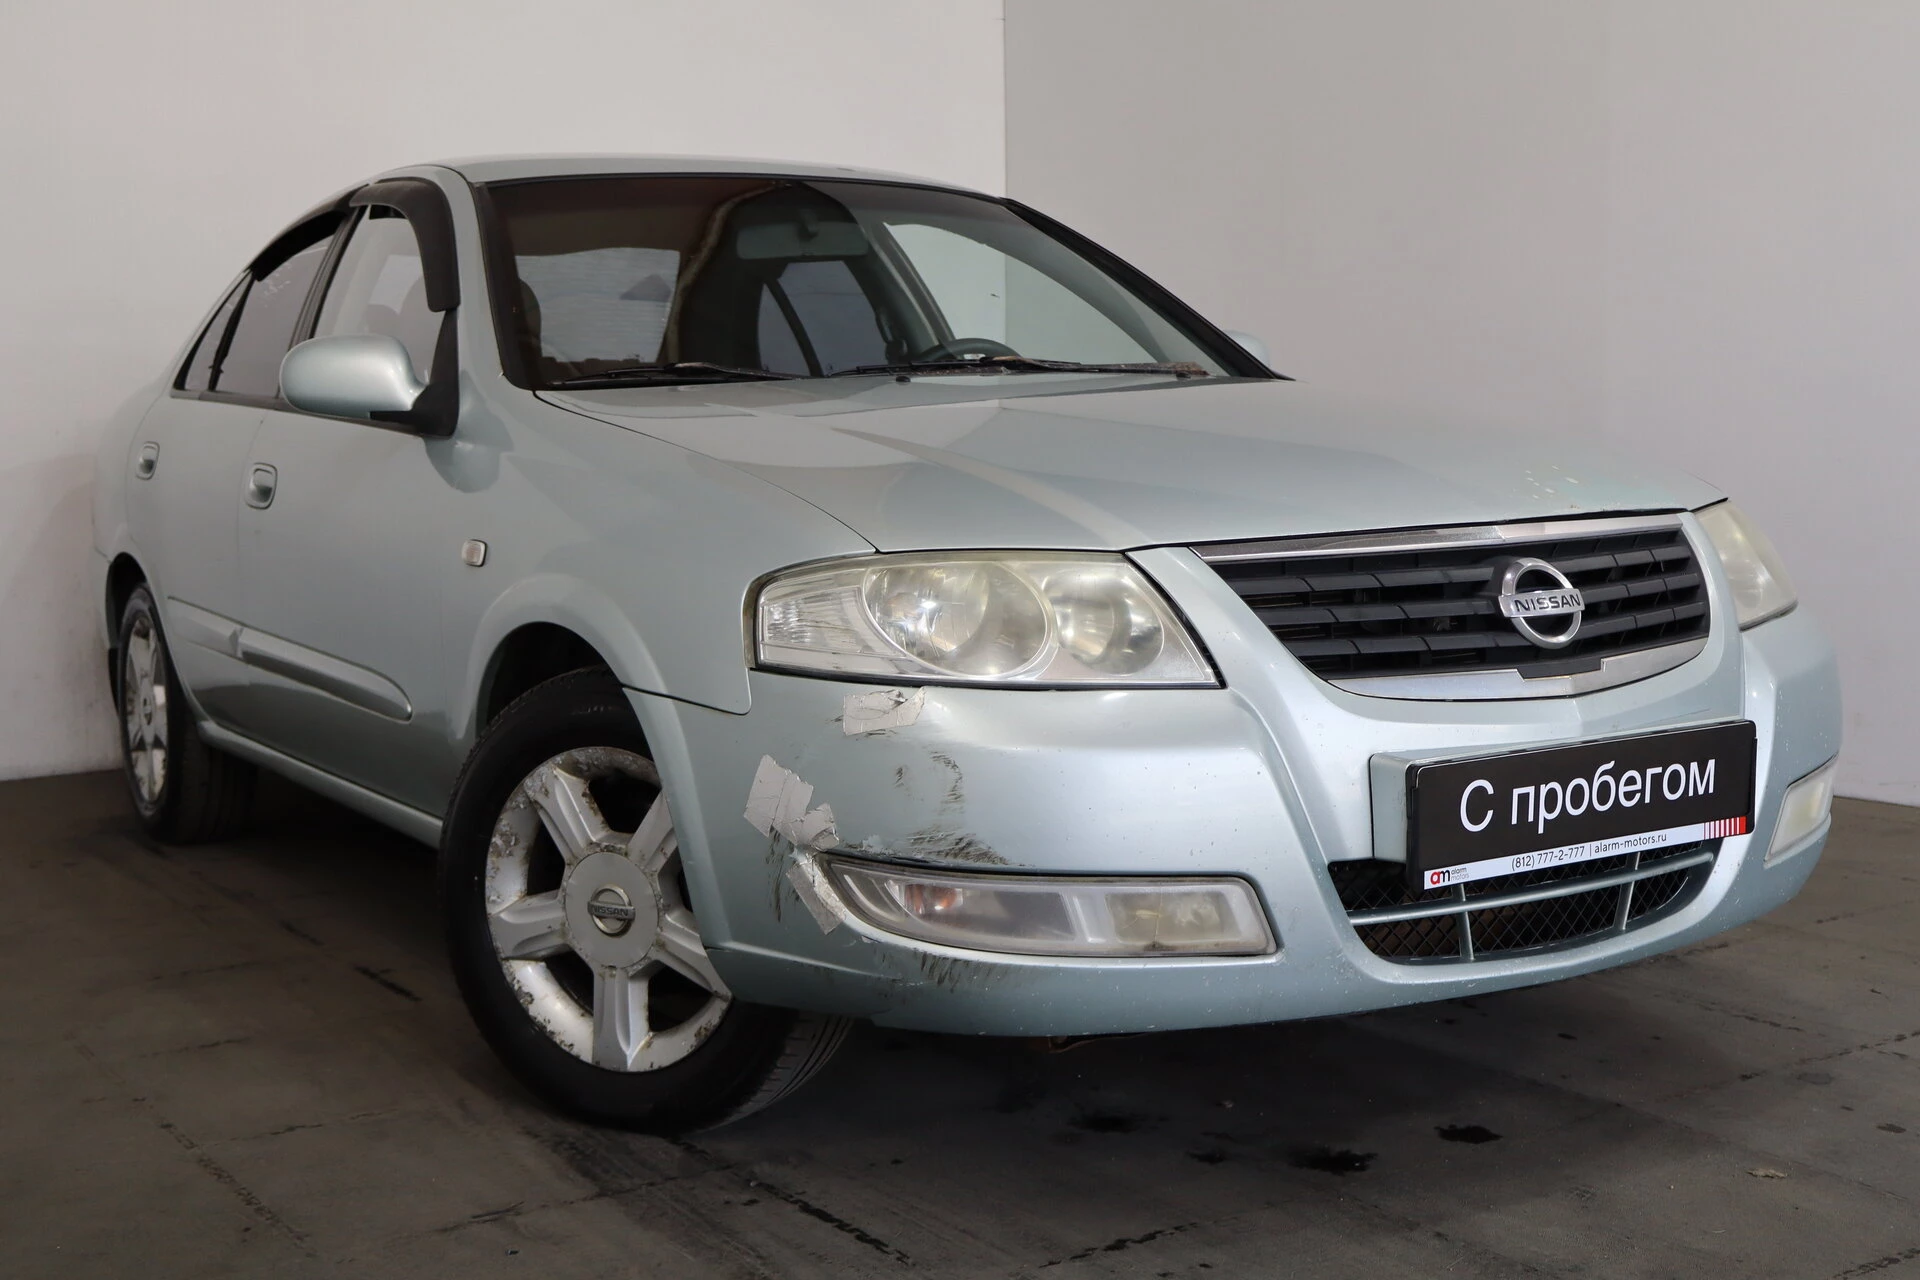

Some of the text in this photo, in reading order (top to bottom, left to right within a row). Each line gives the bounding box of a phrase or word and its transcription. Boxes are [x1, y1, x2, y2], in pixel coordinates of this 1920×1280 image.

[1514, 593, 1581, 612] NISSAN
[1460, 759, 1716, 834] С пробегом
[1511, 833, 1667, 872] (812) 777-2-777 alarm-motors.ru
[1451, 867, 1468, 875] alarm
[591, 904, 629, 917] NISSAN
